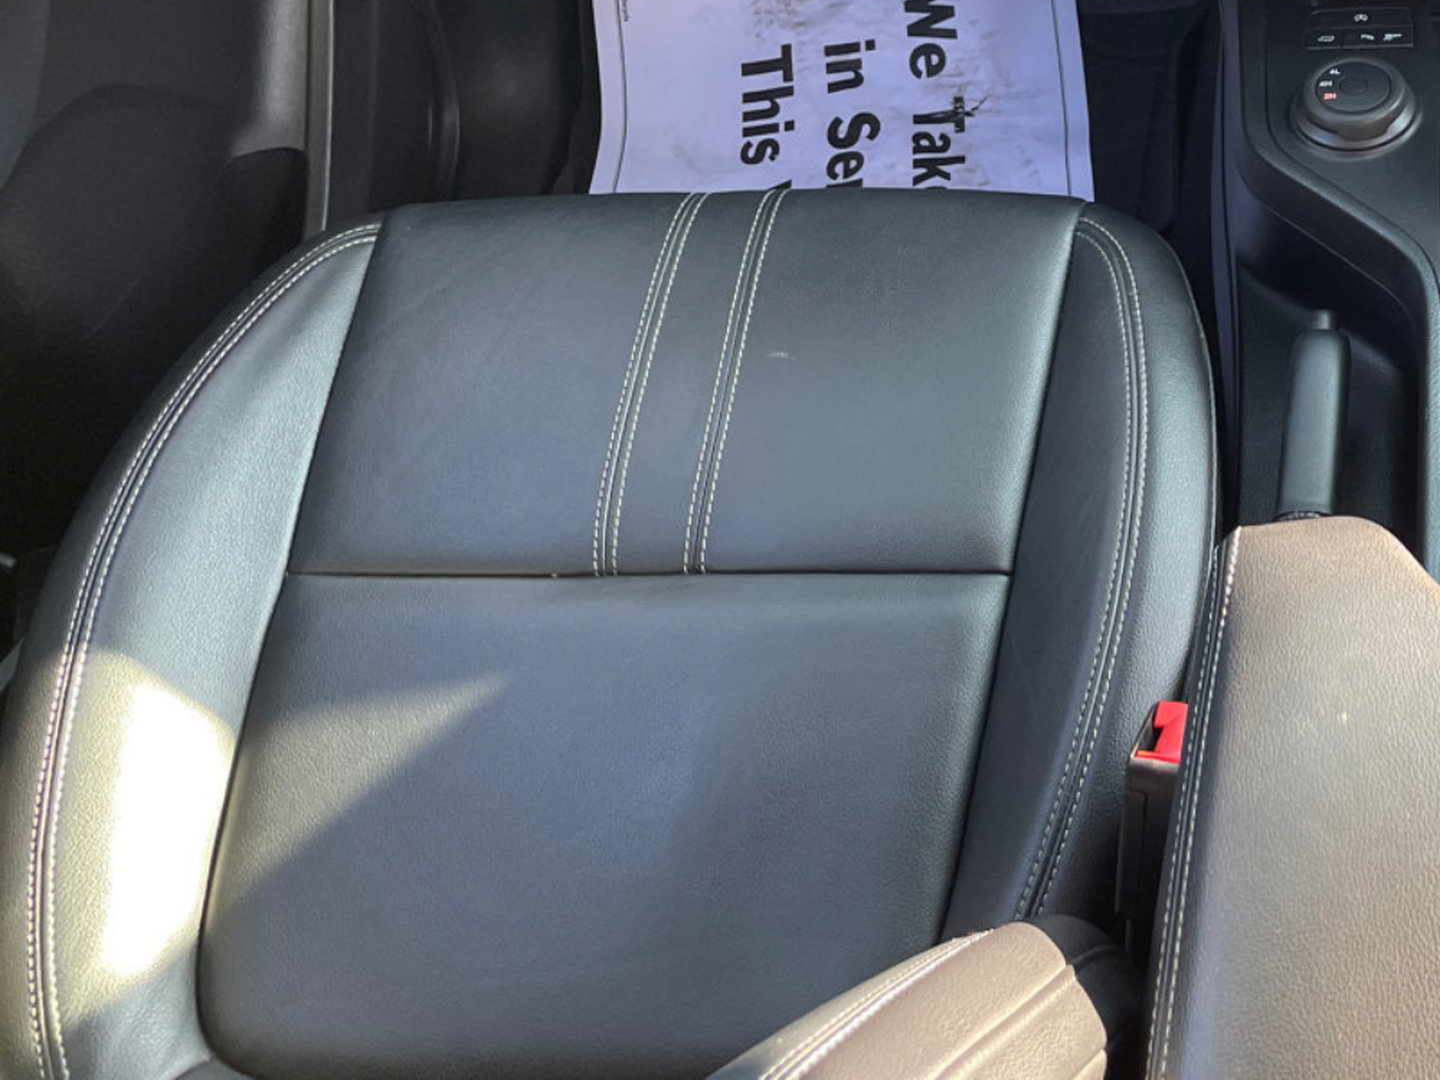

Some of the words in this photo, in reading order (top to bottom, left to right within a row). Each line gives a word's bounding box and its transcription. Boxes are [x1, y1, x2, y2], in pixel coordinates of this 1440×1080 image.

[740, 42, 795, 166] This
[823, 38, 876, 94] in
[912, 95, 966, 189] Tak
